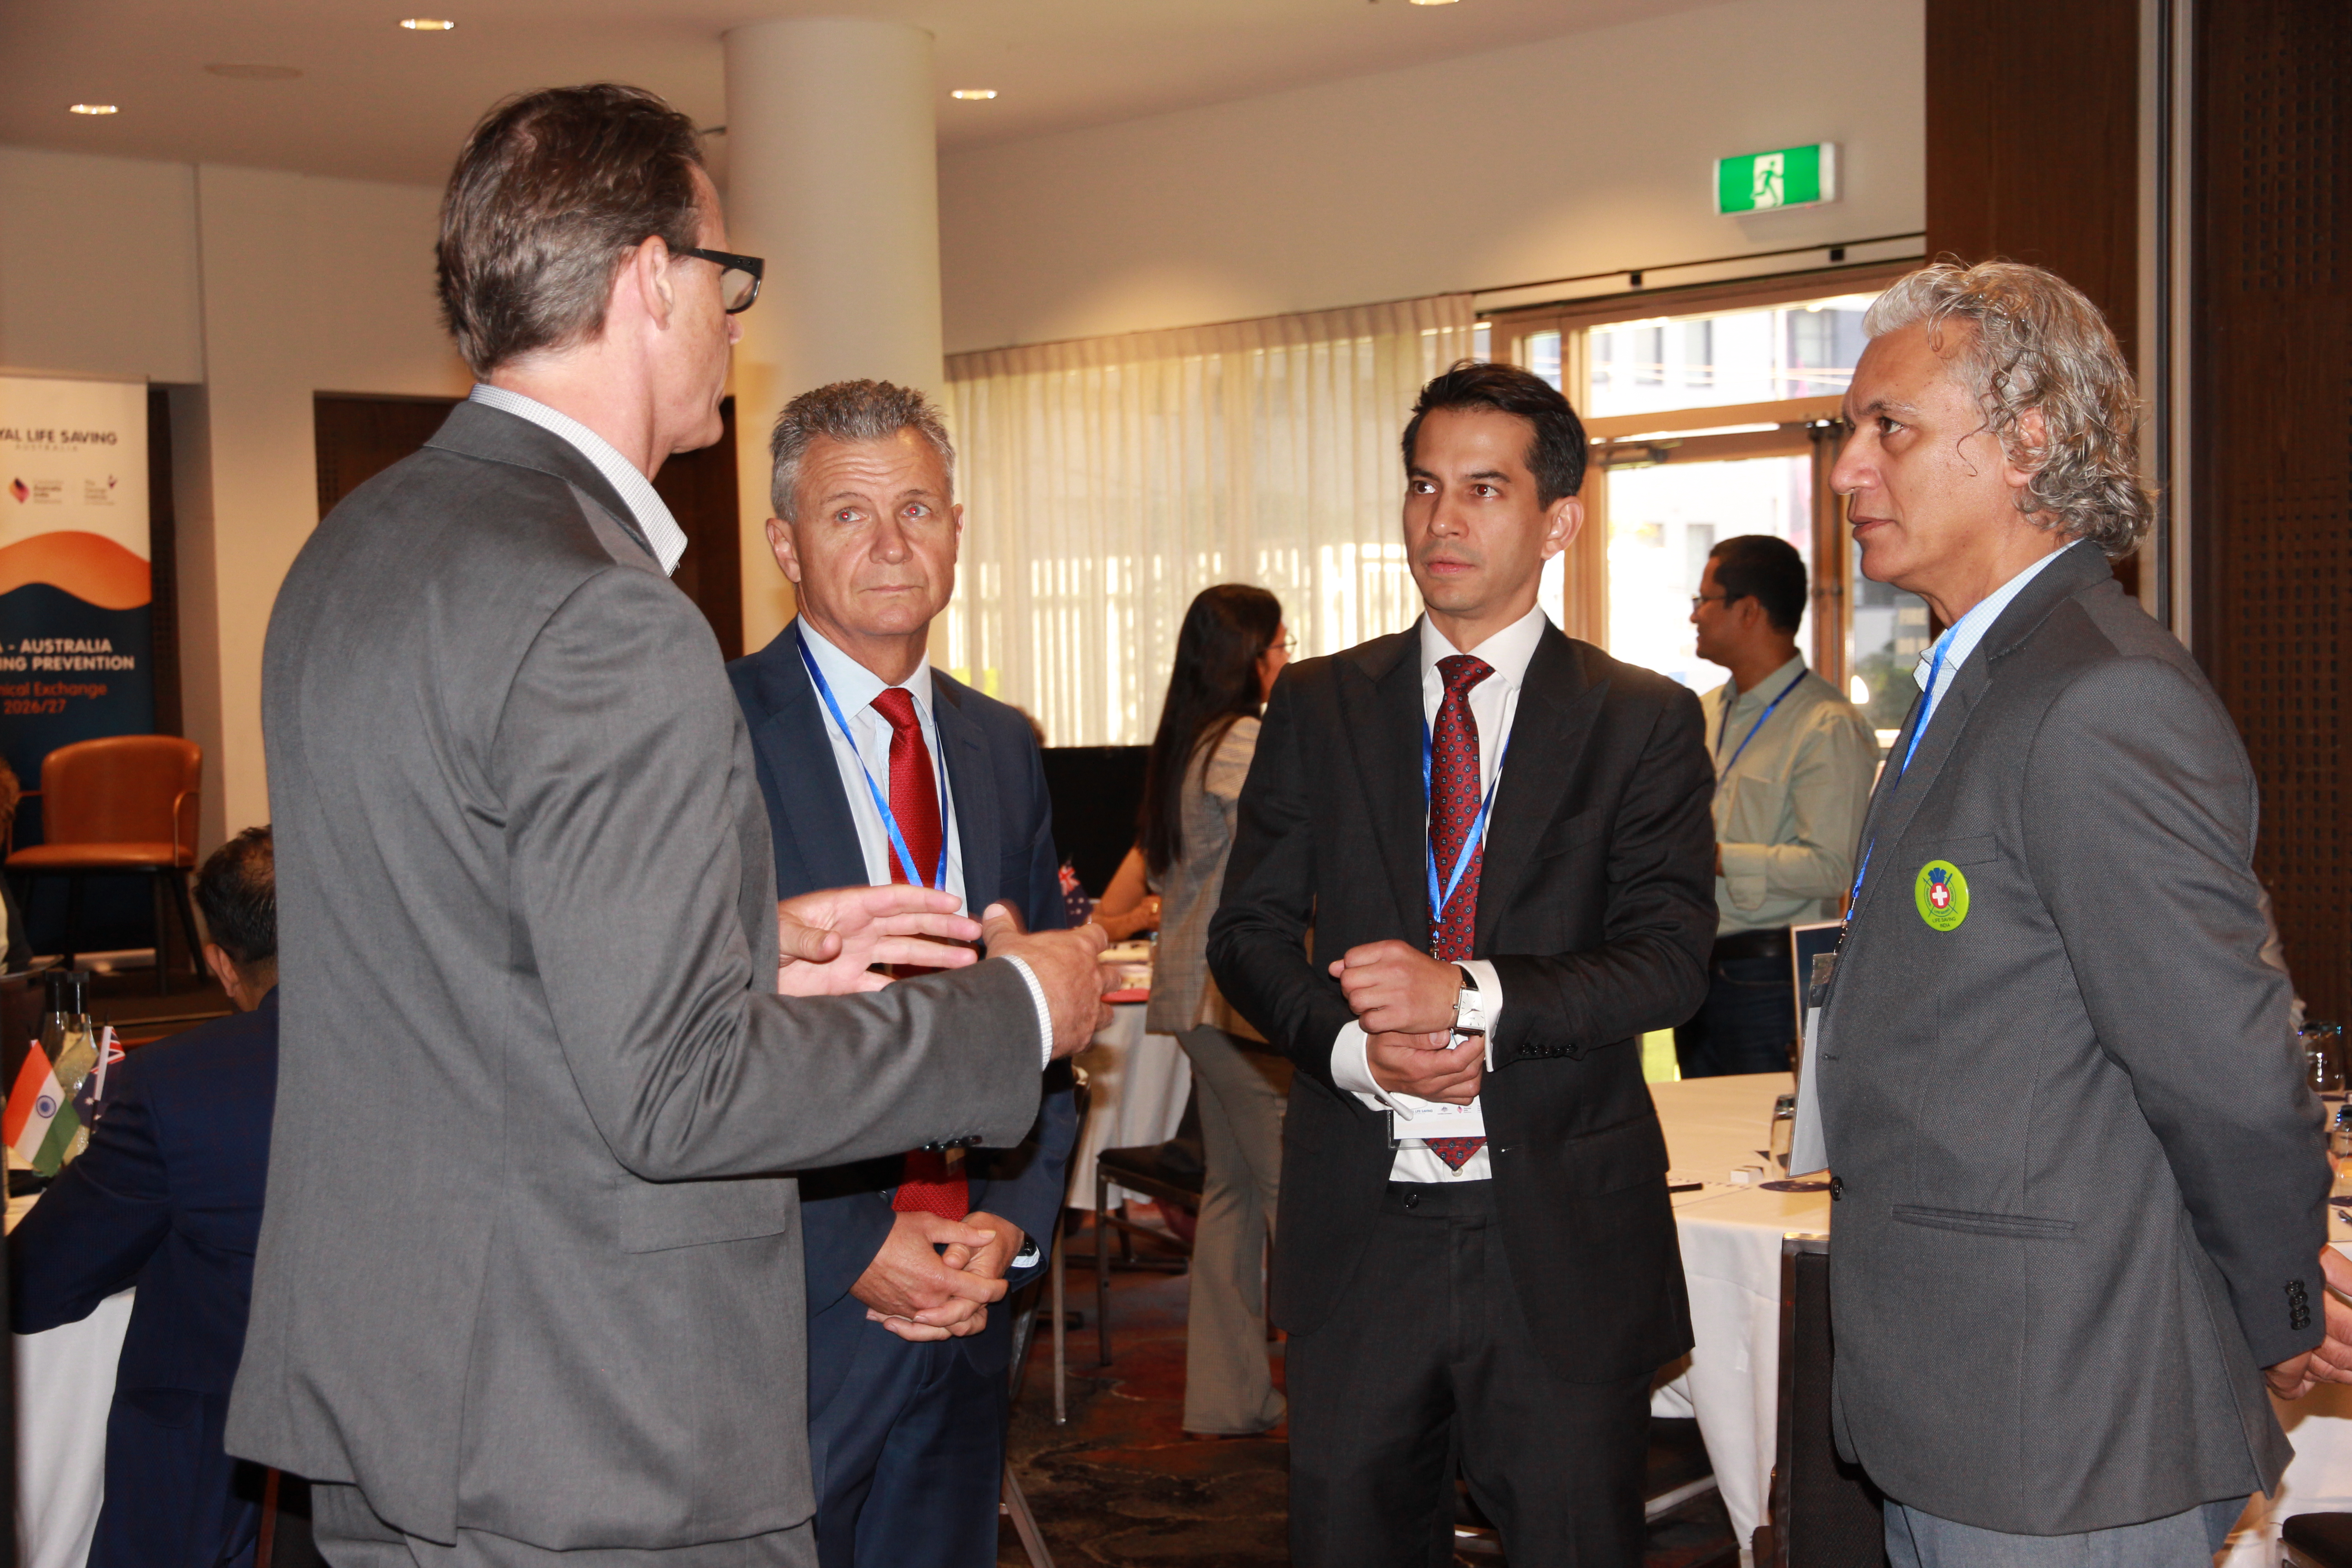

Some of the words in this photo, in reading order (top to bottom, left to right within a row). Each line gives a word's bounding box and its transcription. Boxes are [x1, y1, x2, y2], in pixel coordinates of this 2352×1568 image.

[27, 429, 54, 443] LIFE
[61, 430, 117, 445] SAVING
[20, 638, 113, 653] AUSTRALIA
[32, 655, 135, 671] PREVENTION
[34, 681, 108, 699] Exchange
[4, 698, 66, 714] 2026/27
